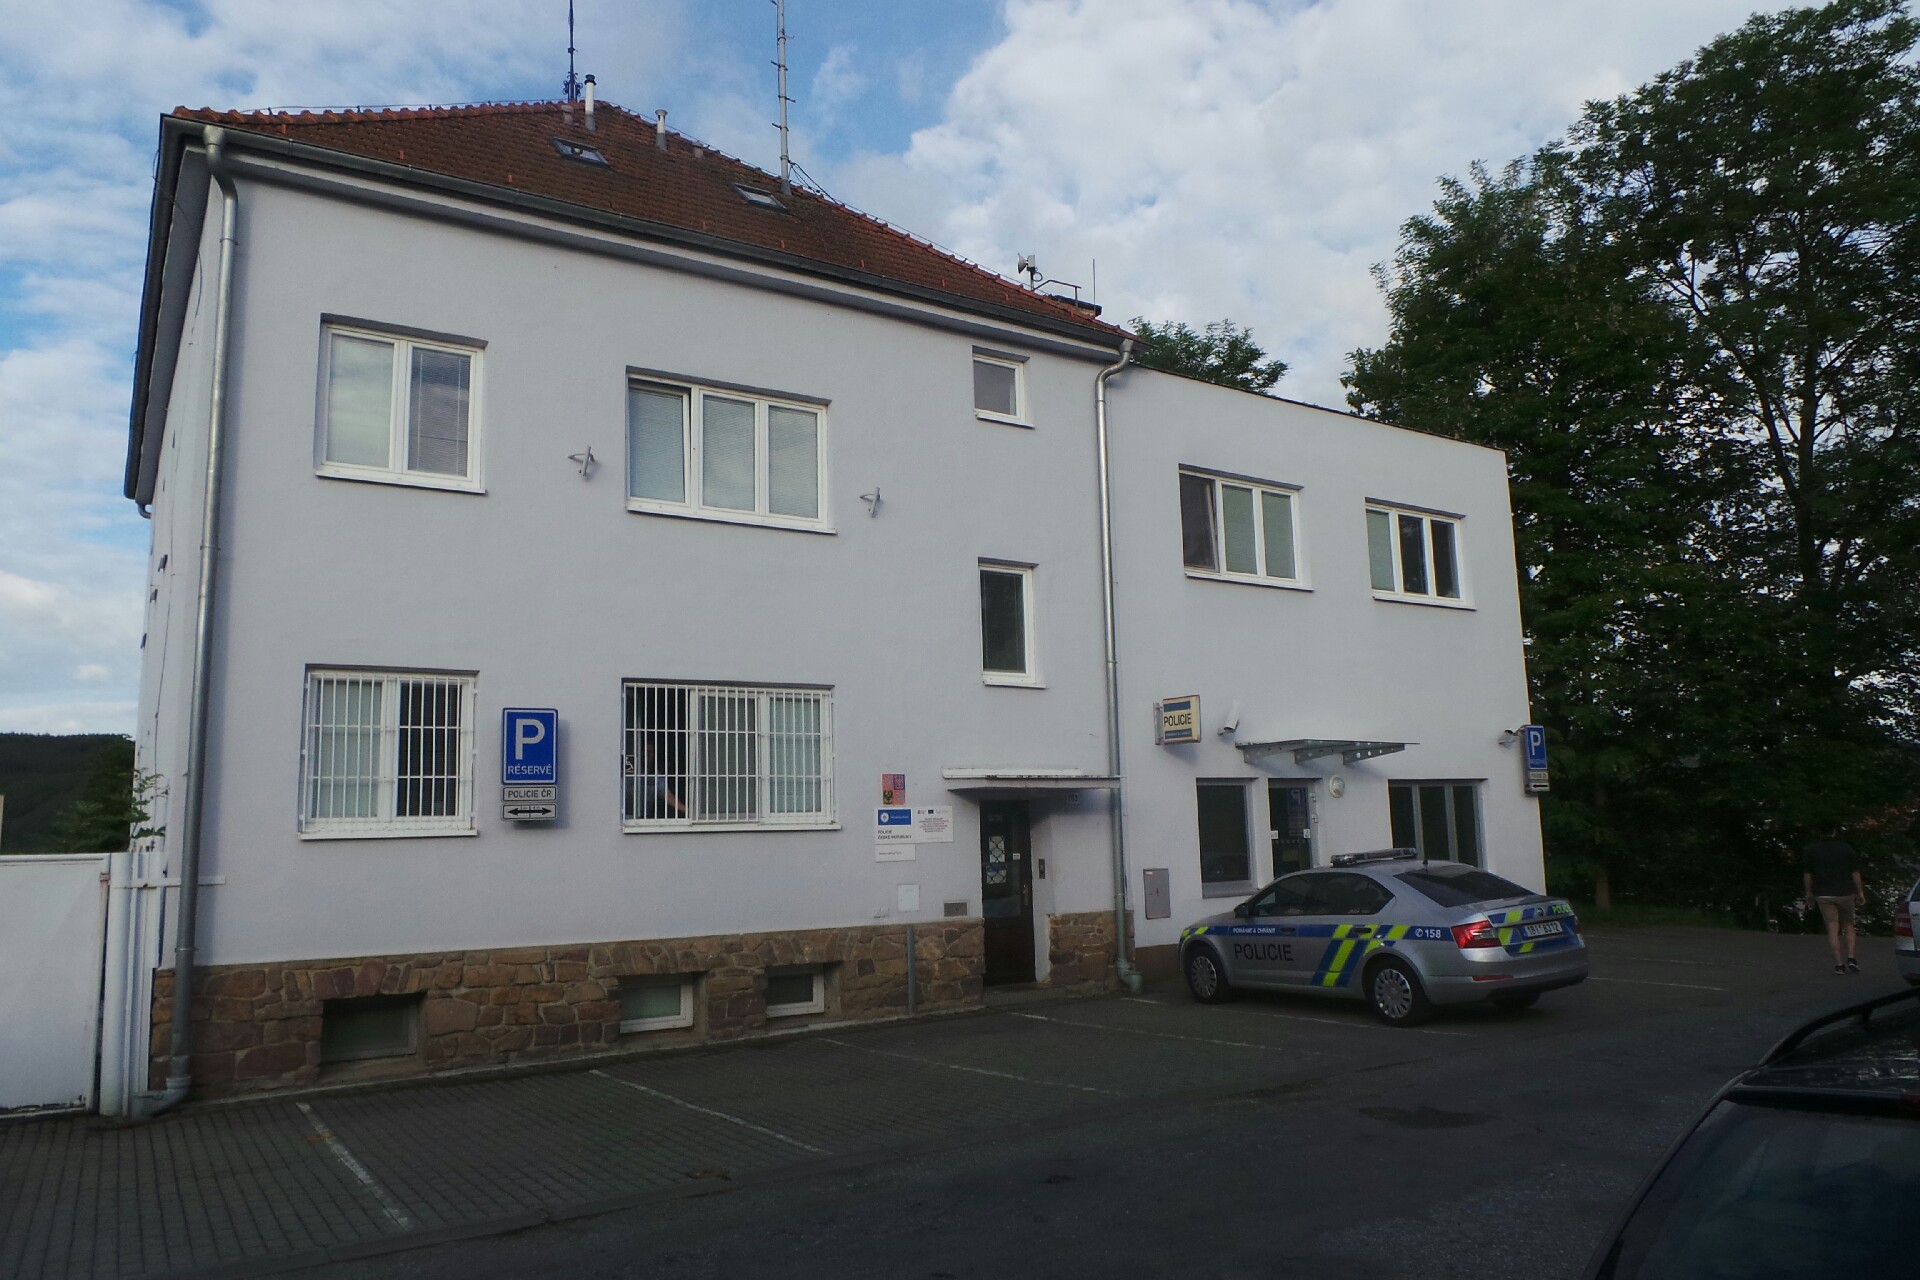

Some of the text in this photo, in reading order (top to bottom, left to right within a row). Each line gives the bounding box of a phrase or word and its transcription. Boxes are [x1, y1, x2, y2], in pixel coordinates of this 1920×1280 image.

[1163, 713, 1192, 727] POLICIE
[515, 718, 545, 760] P
[1529, 730, 1541, 756] P
[508, 788, 552, 799] POLICIE ČR
[1424, 929, 1441, 939] 158
[1233, 943, 1294, 961] POLICIE
